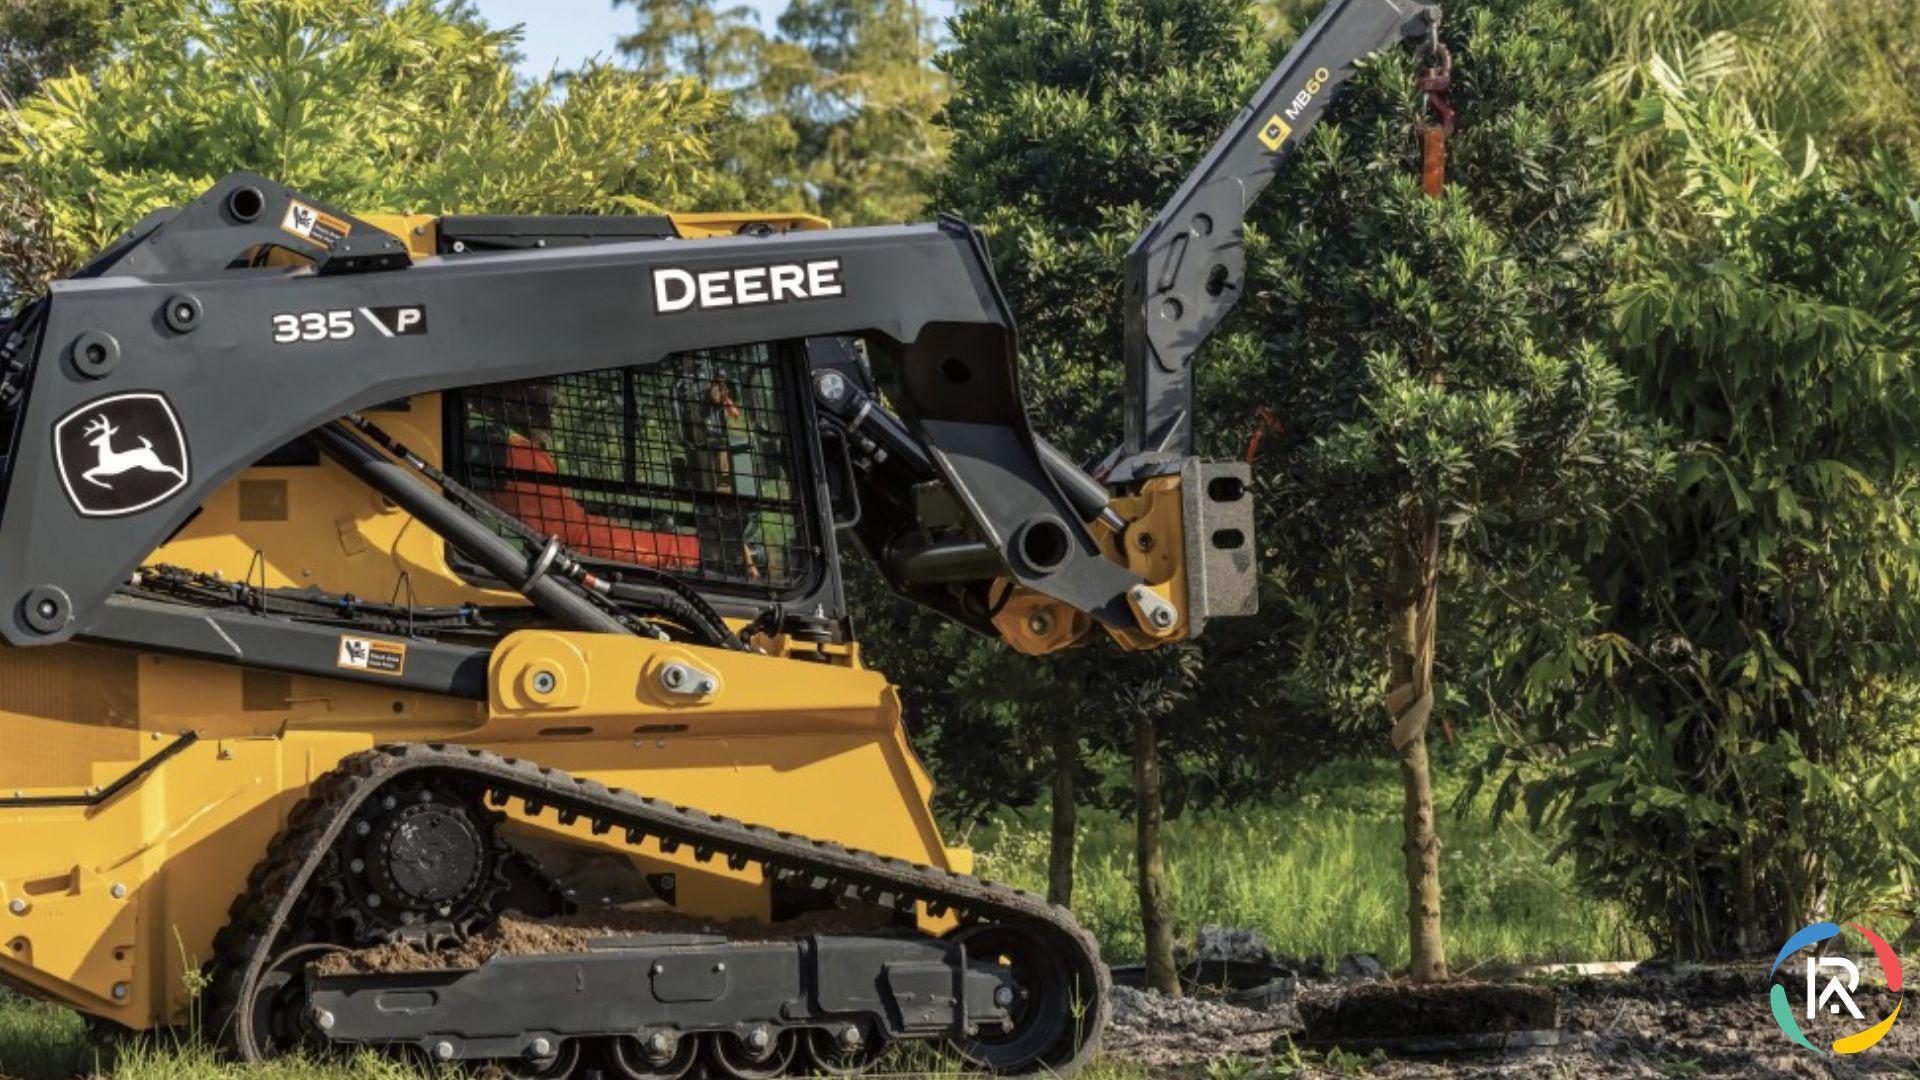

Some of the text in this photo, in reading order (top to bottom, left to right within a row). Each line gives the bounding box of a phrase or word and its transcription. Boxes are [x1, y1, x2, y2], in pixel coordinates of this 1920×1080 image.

[1285, 67, 1329, 120] MB60
[653, 259, 842, 313] DEERE
[273, 310, 355, 342] 335
